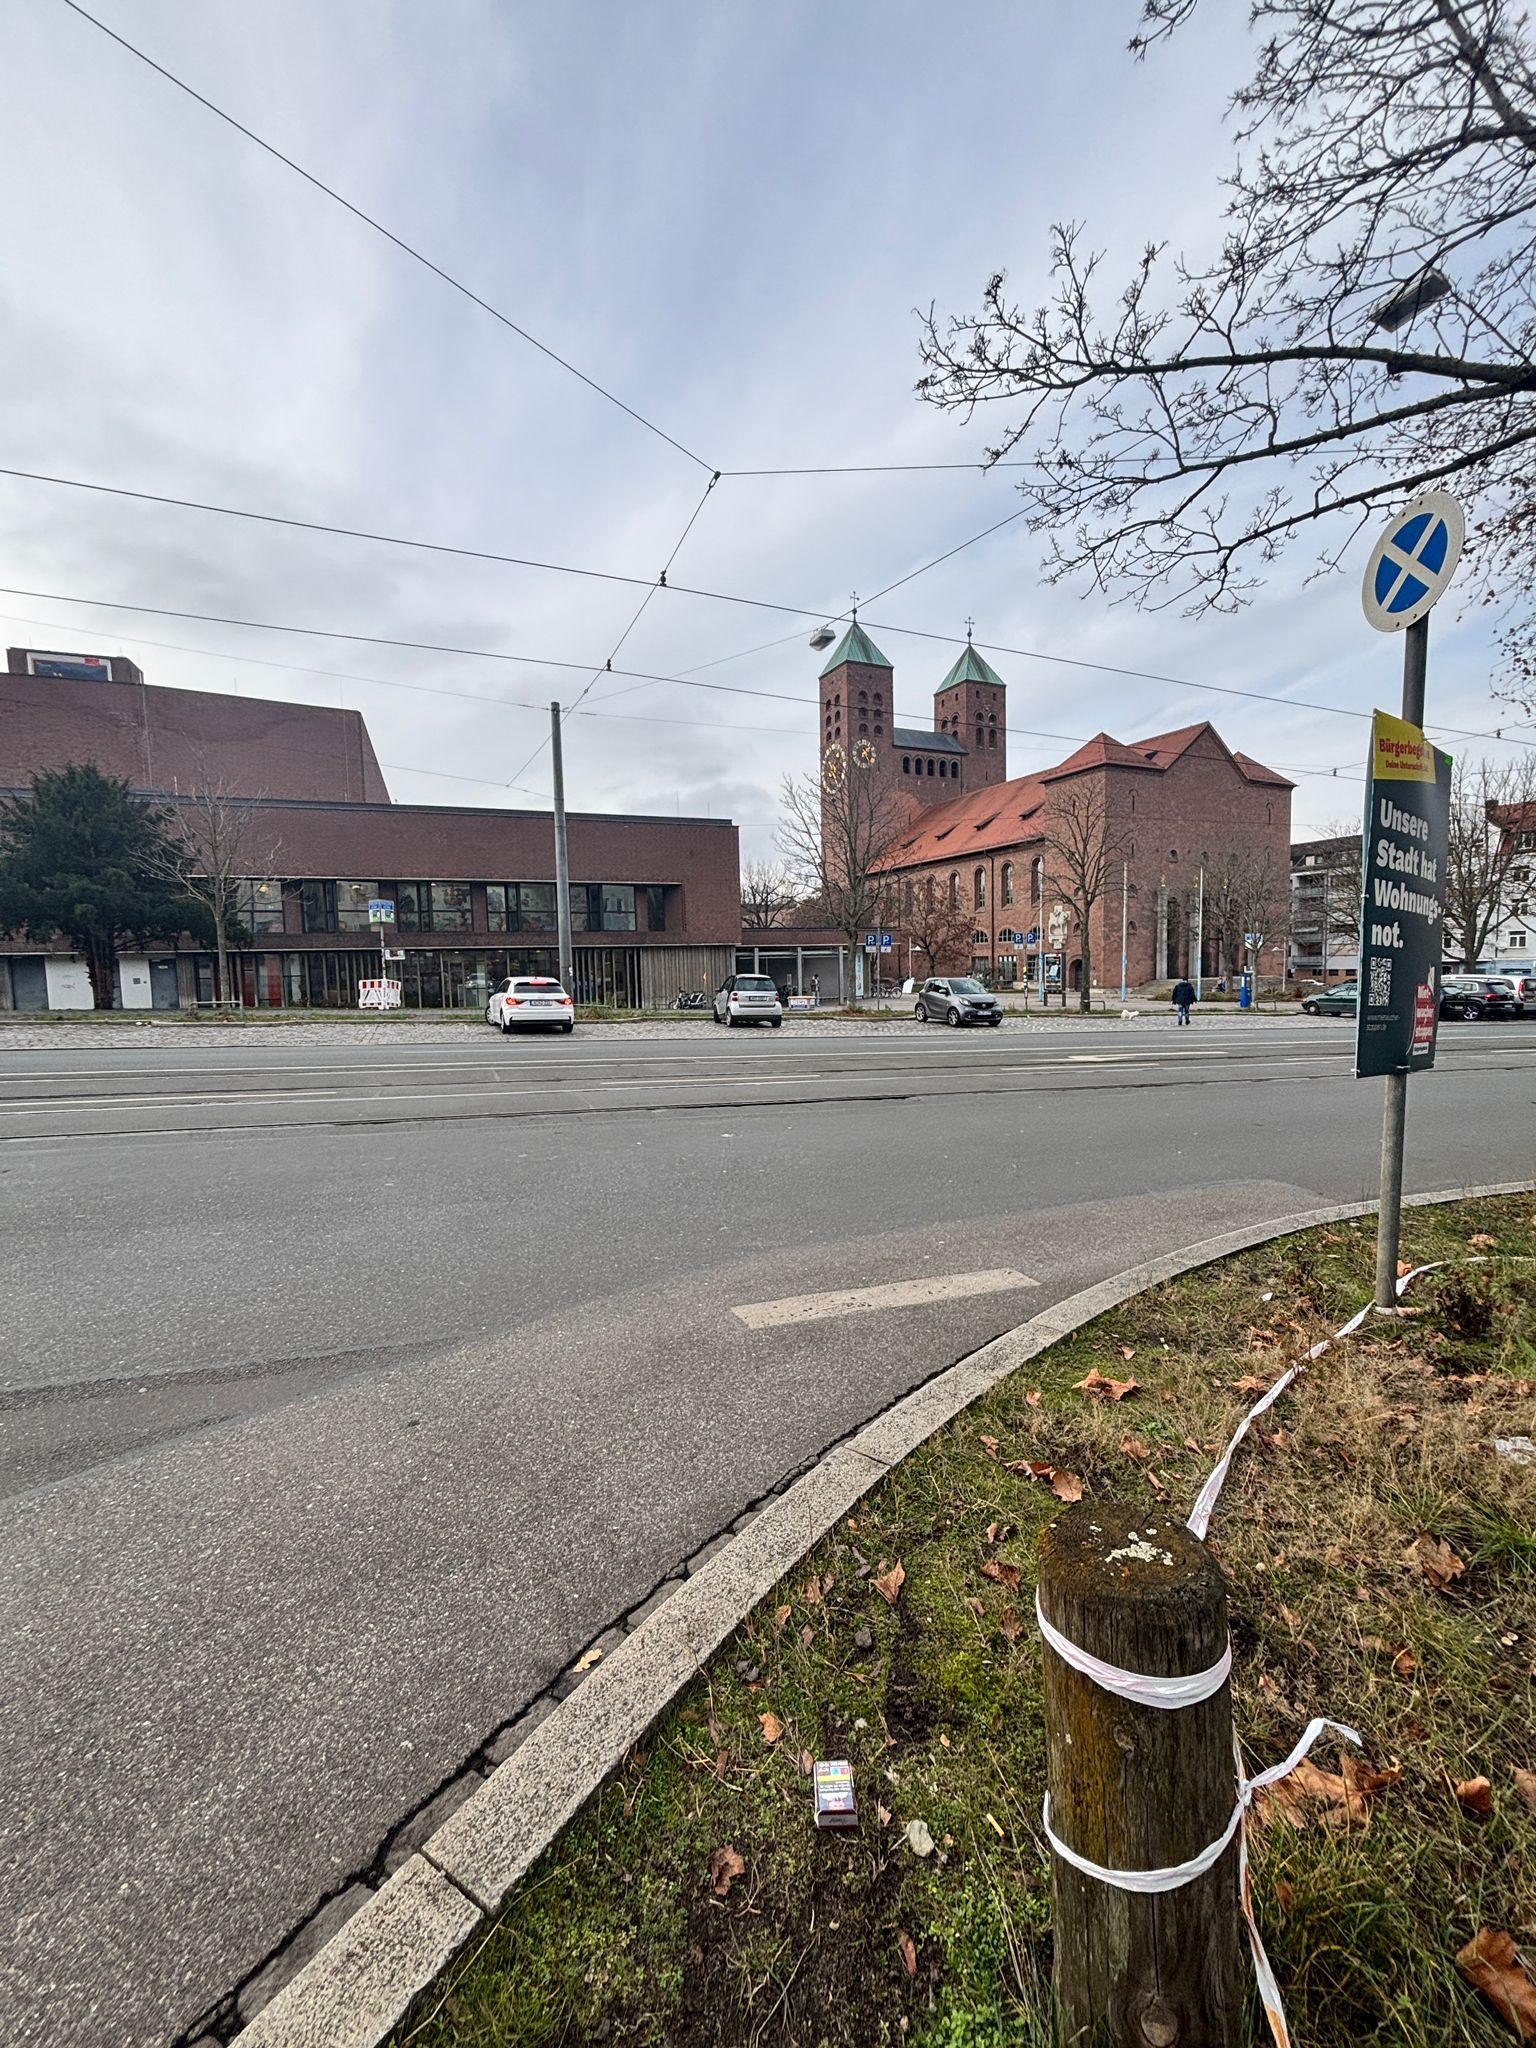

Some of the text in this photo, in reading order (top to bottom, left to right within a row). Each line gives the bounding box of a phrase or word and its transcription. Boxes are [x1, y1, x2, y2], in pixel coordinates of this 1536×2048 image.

[1380, 798, 1429, 842] Unsere
[1376, 839, 1437, 883] Stadt hat
[1374, 878, 1442, 925] Wohnungs-
[1371, 921, 1404, 949] not.
